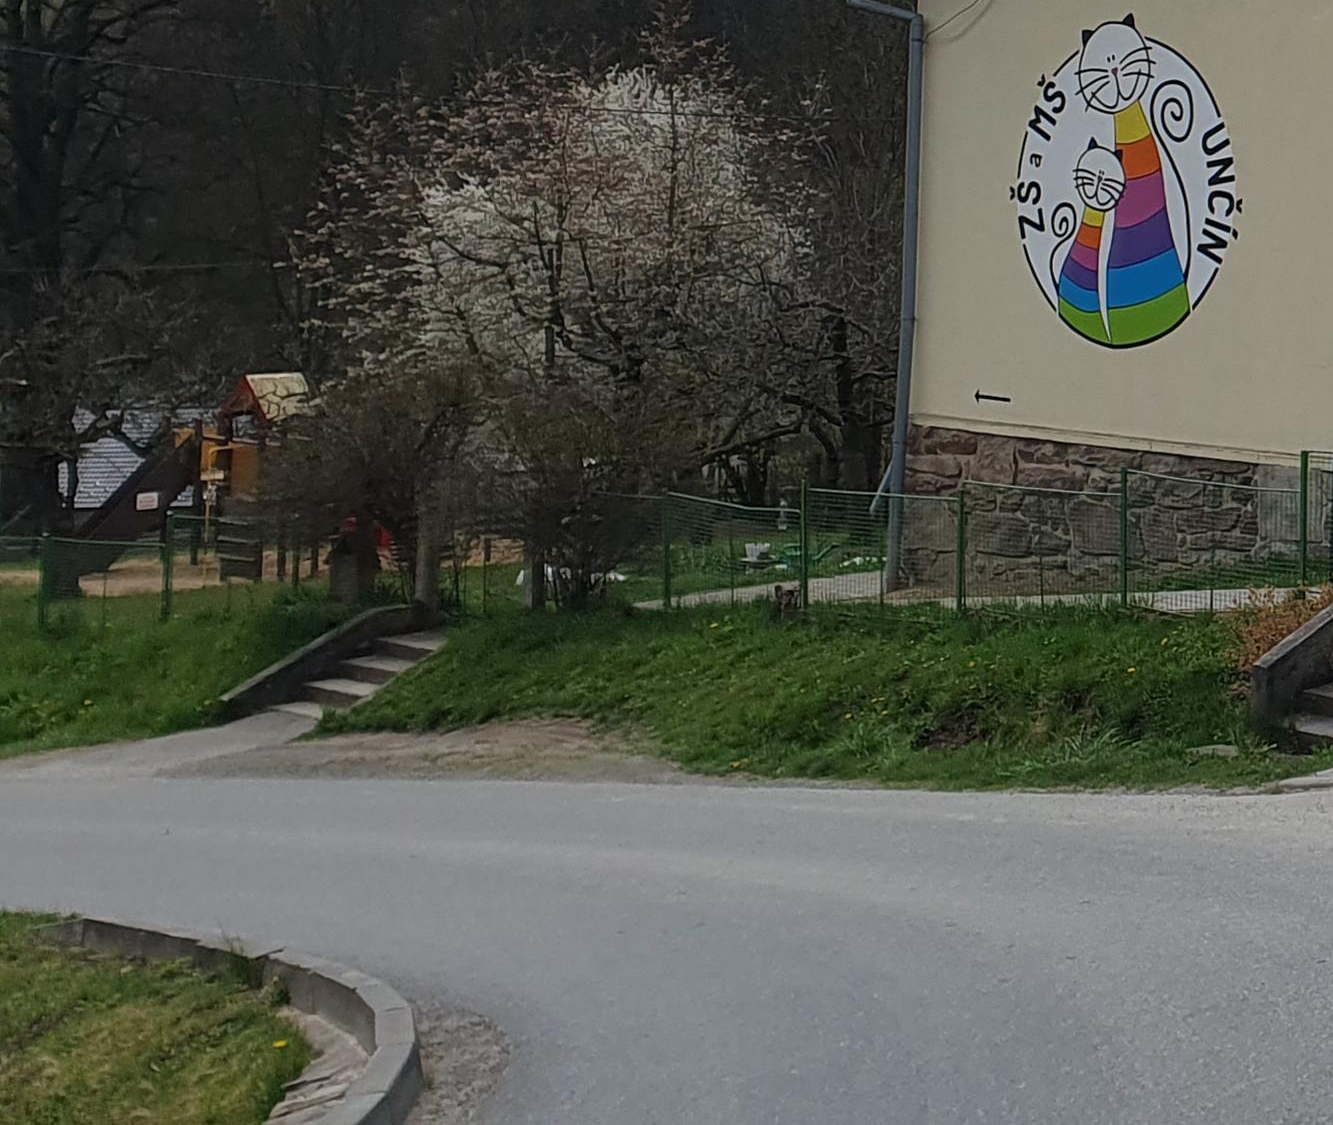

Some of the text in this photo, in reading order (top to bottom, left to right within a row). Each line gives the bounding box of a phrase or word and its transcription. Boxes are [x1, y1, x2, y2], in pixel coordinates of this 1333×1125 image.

[1009, 74, 1244, 265] ZŠ a MŠ UNČÍN
